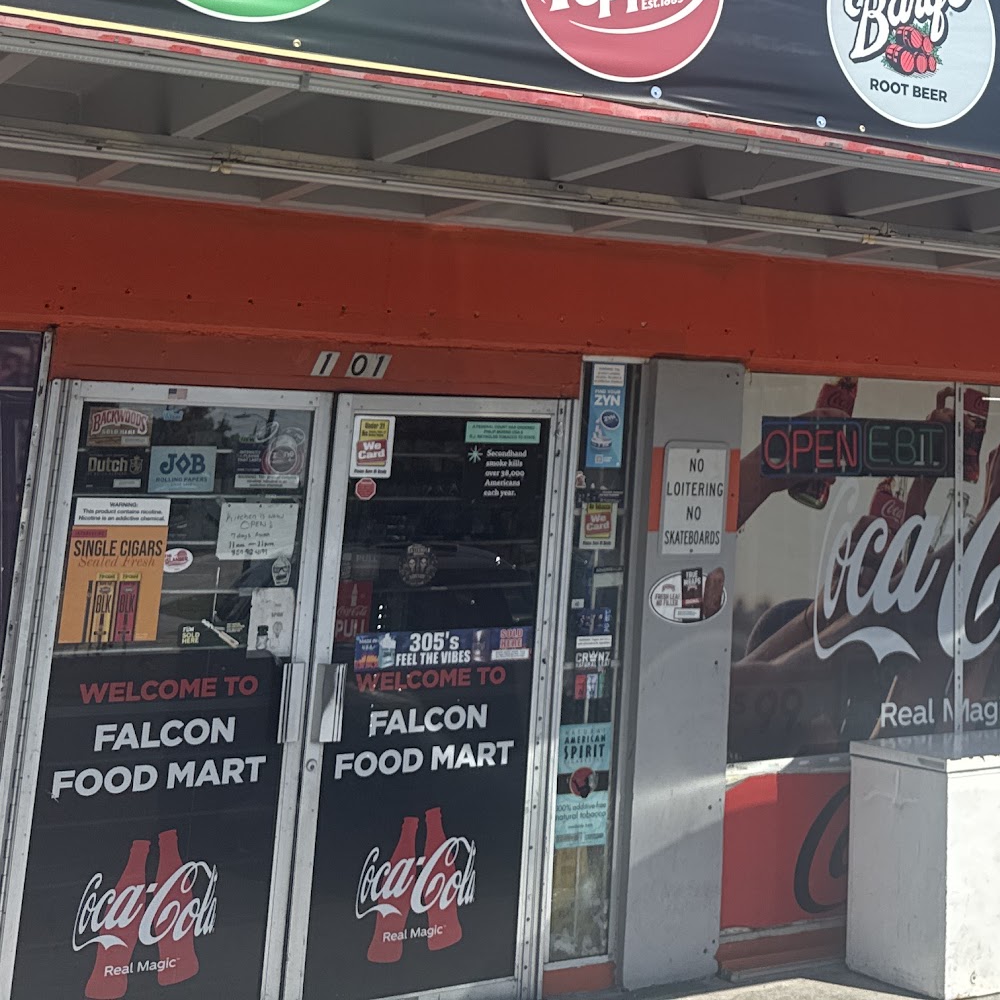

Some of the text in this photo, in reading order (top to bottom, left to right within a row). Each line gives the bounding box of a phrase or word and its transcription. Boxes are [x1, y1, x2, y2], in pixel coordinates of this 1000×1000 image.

[869, 77, 948, 102] ROOT BEER
[594, 394, 621, 407] ZYN
[91, 408, 149, 435] BACKWOODS
[358, 449, 386, 460] Card
[363, 441, 382, 451] We
[486, 449, 527, 458] Secondhand
[764, 428, 858, 470] OPEN
[88, 456, 128, 473] Dutch
[159, 453, 206, 475] JOB
[485, 459, 523, 468] smoke kills
[689, 458, 705, 473] NO
[501, 469, 525, 478] 38,000
[484, 479, 520, 487] Americans
[666, 481, 724, 497] LOITERING
[483, 488, 517, 498] each year.
[590, 514, 606, 523] We
[685, 506, 702, 521] NO
[586, 521, 610, 531] Card
[664, 530, 721, 546] SKATEBOARDS
[73, 540, 163, 557] SINGLE CIGARS
[78, 556, 118, 568] Sealed
[122, 556, 155, 567] Fresh
[95, 594, 112, 614] BLK
[335, 618, 366, 638] PULL
[409, 631, 460, 653] 305's
[395, 650, 472, 667] FEEL THE VIBES
[356, 666, 506, 693] WELCOME TO
[79, 675, 259, 704] WELCOME TO
[368, 703, 488, 737] FALCON
[880, 698, 935, 728] Real
[93, 716, 236, 752] FALCON
[564, 734, 606, 744] AMERICAN
[334, 740, 515, 779] FOOD MART
[563, 743, 606, 760] SPIRIT
[51, 755, 267, 799] FOOD MART
[580, 810, 607, 819] tobacco
[355, 836, 476, 919] Coca-Cola
[72, 861, 218, 951] Coca-Cola
[382, 924, 444, 943] Real Magic
[104, 958, 178, 977] Real Magic
